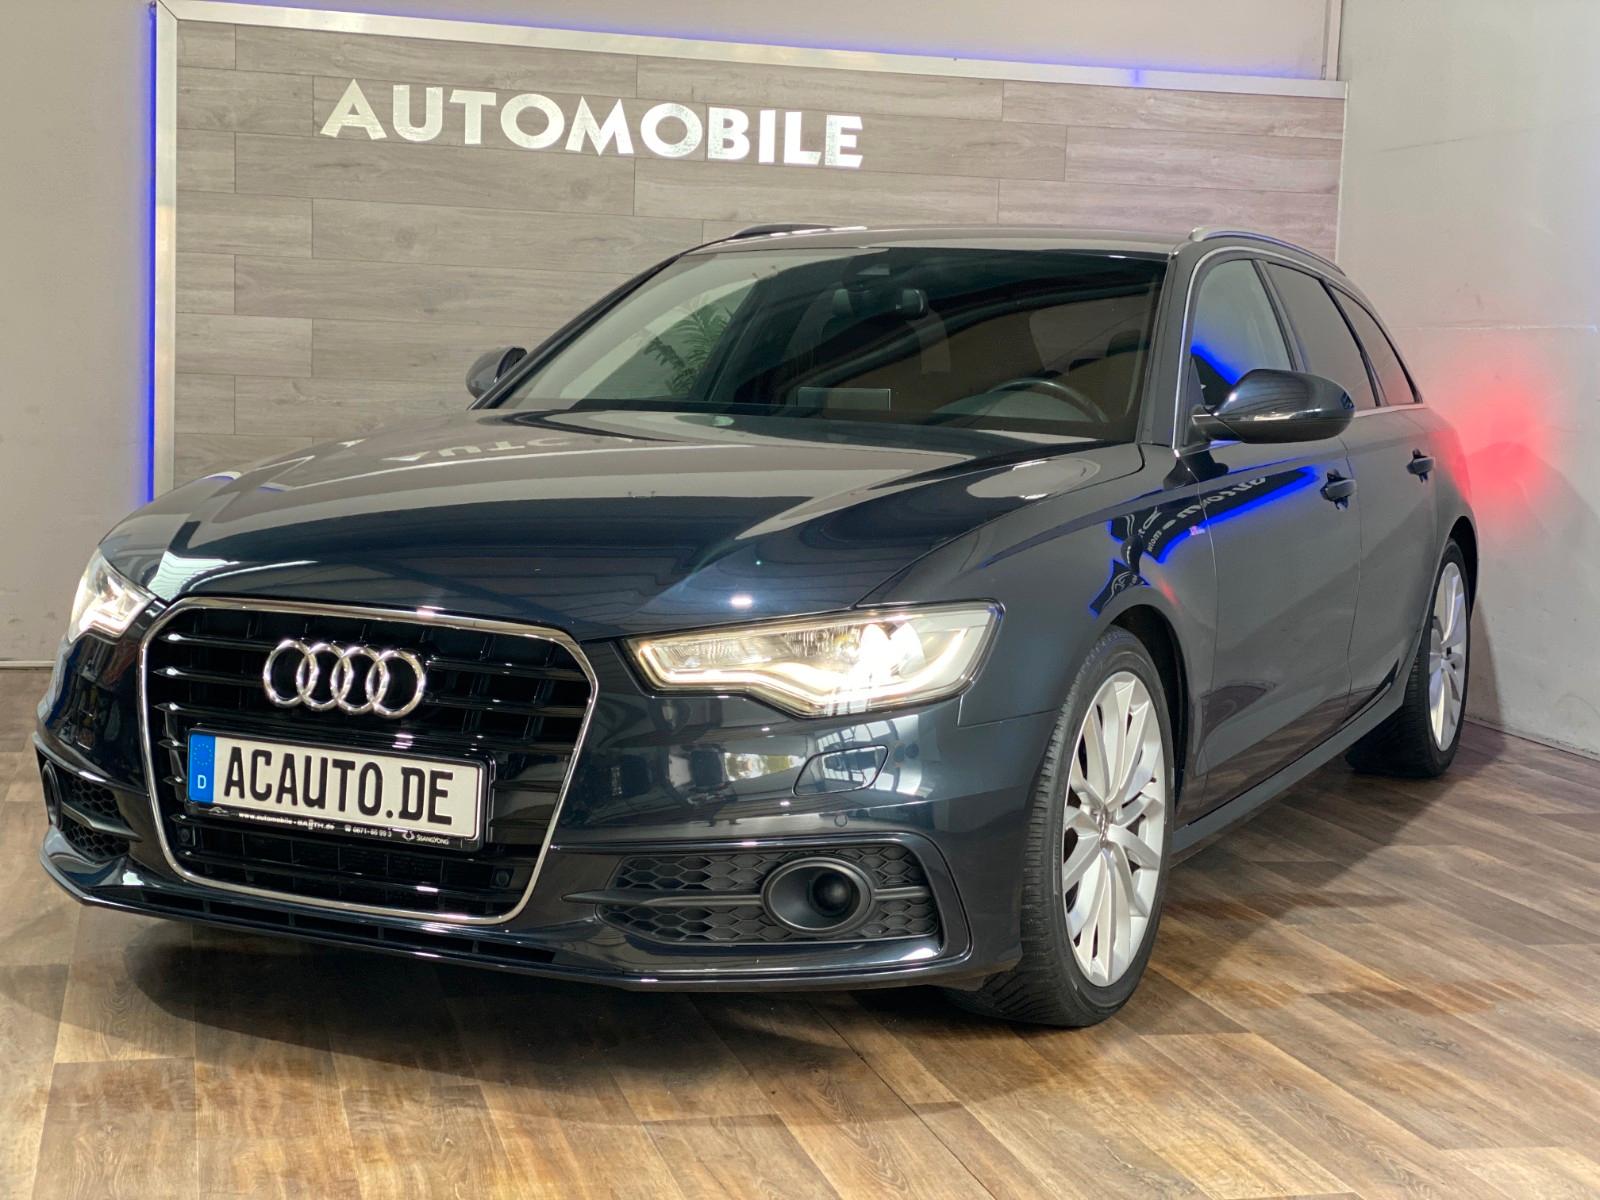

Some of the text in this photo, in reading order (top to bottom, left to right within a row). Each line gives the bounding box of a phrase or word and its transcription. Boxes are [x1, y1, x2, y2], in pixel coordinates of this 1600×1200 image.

[320, 79, 863, 168] AUTOMOBILE
[197, 774, 206, 789] D
[224, 746, 453, 825] ACAUTO.DE
